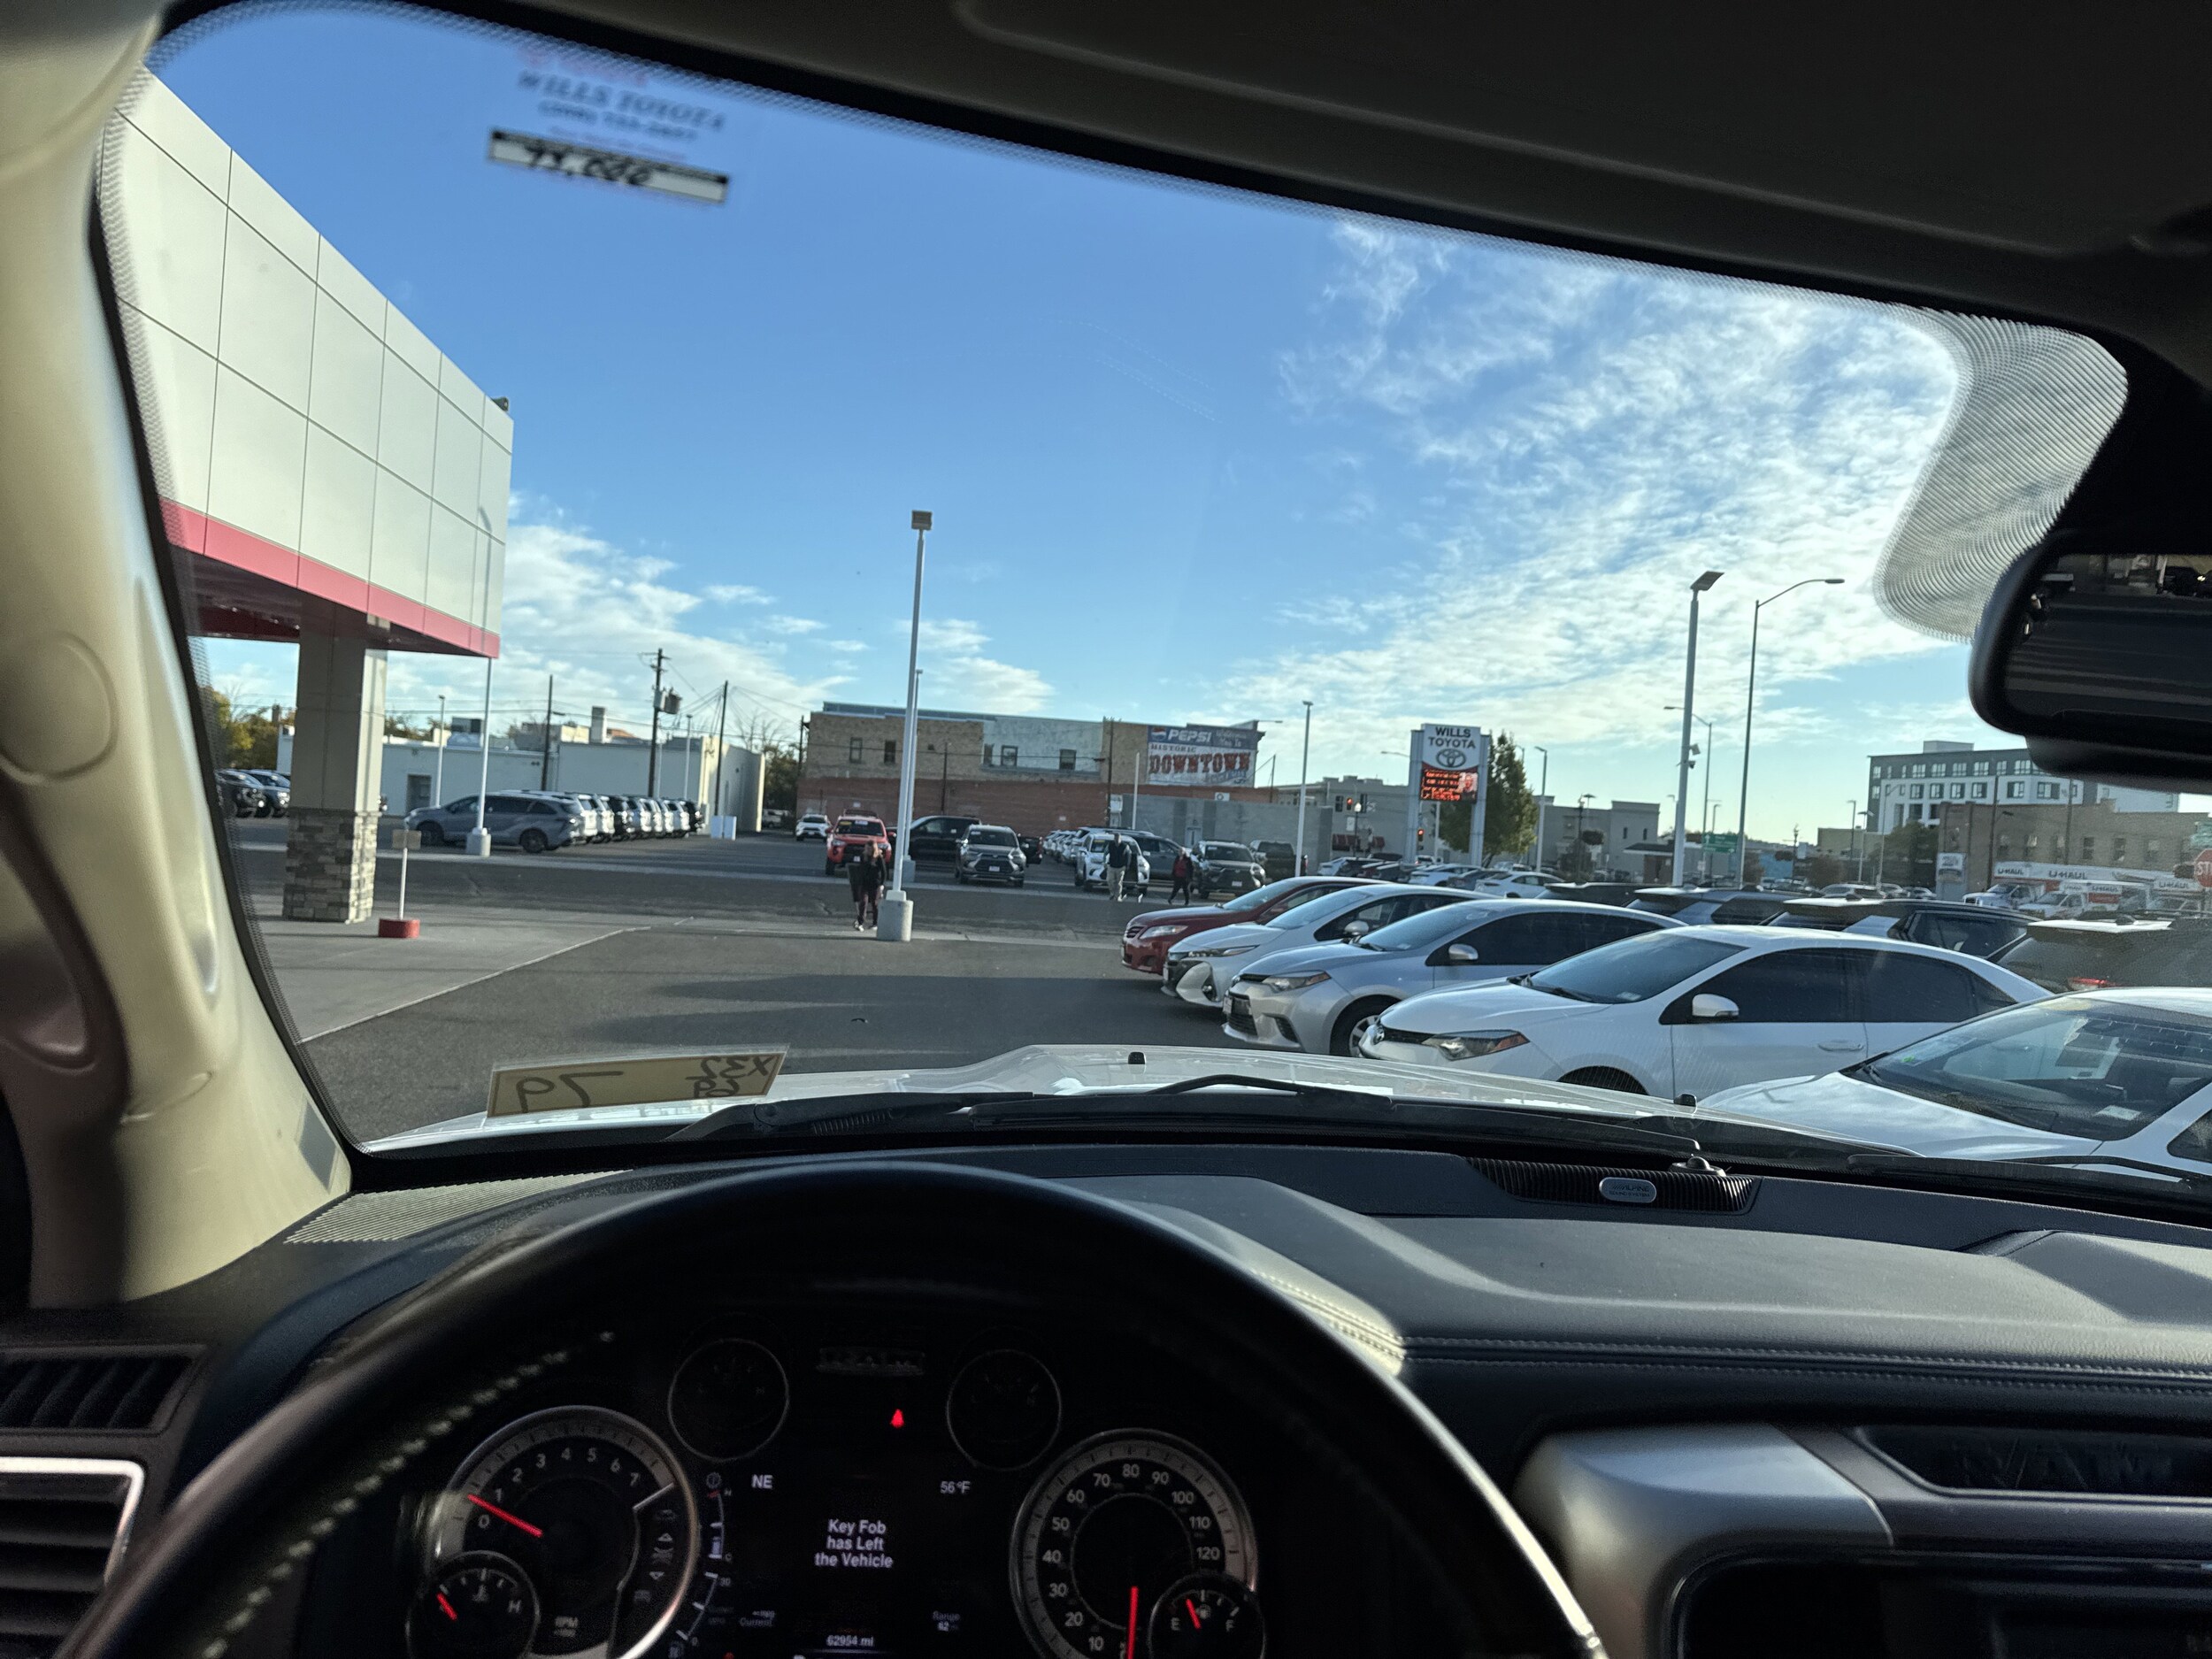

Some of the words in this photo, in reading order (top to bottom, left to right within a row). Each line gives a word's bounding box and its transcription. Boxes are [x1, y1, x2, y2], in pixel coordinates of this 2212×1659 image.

[1168, 729, 1212, 743] PEPSI
[1435, 726, 1471, 738] WILLS
[1428, 736, 1476, 749] TOYOTA
[1148, 753, 1251, 774] DOWNTOWN
[2049, 871, 2086, 879] U-HAUL
[1617, 1184, 1650, 1193] ALPINE
[535, 1453, 546, 1469] 3
[561, 1448, 571, 1460] 4
[588, 1448, 597, 1462] 5
[610, 1458, 620, 1473] 6
[1122, 1463, 1141, 1479] 80
[512, 1467, 523, 1483] 2
[630, 1472, 641, 1486] 7
[750, 1474, 773, 1489] NE
[1093, 1472, 1111, 1487] 70
[1151, 1471, 1170, 1486] 90
[940, 1480, 971, 1494] 56°F
[495, 1488, 503, 1502] 1
[1066, 1489, 1085, 1503] 60
[1171, 1491, 1194, 1504] 100
[478, 1514, 490, 1529] 0
[827, 1517, 856, 1536] Key
[858, 1518, 887, 1535] Fob
[1051, 1517, 1070, 1531] 50
[1189, 1516, 1211, 1530] 110
[826, 1534, 853, 1550] has
[856, 1536, 884, 1551] Left
[814, 1551, 838, 1567] the
[841, 1551, 894, 1569] Vehicle
[1041, 1549, 1063, 1563] 40
[1196, 1546, 1220, 1561] 120
[1048, 1582, 1069, 1598] 30
[507, 1599, 522, 1614] H
[1064, 1611, 1084, 1627] 20
[1171, 1617, 1181, 1632] E
[1225, 1619, 1236, 1632] F
[861, 1636, 874, 1647] mi
[1088, 1636, 1105, 1652] 10
